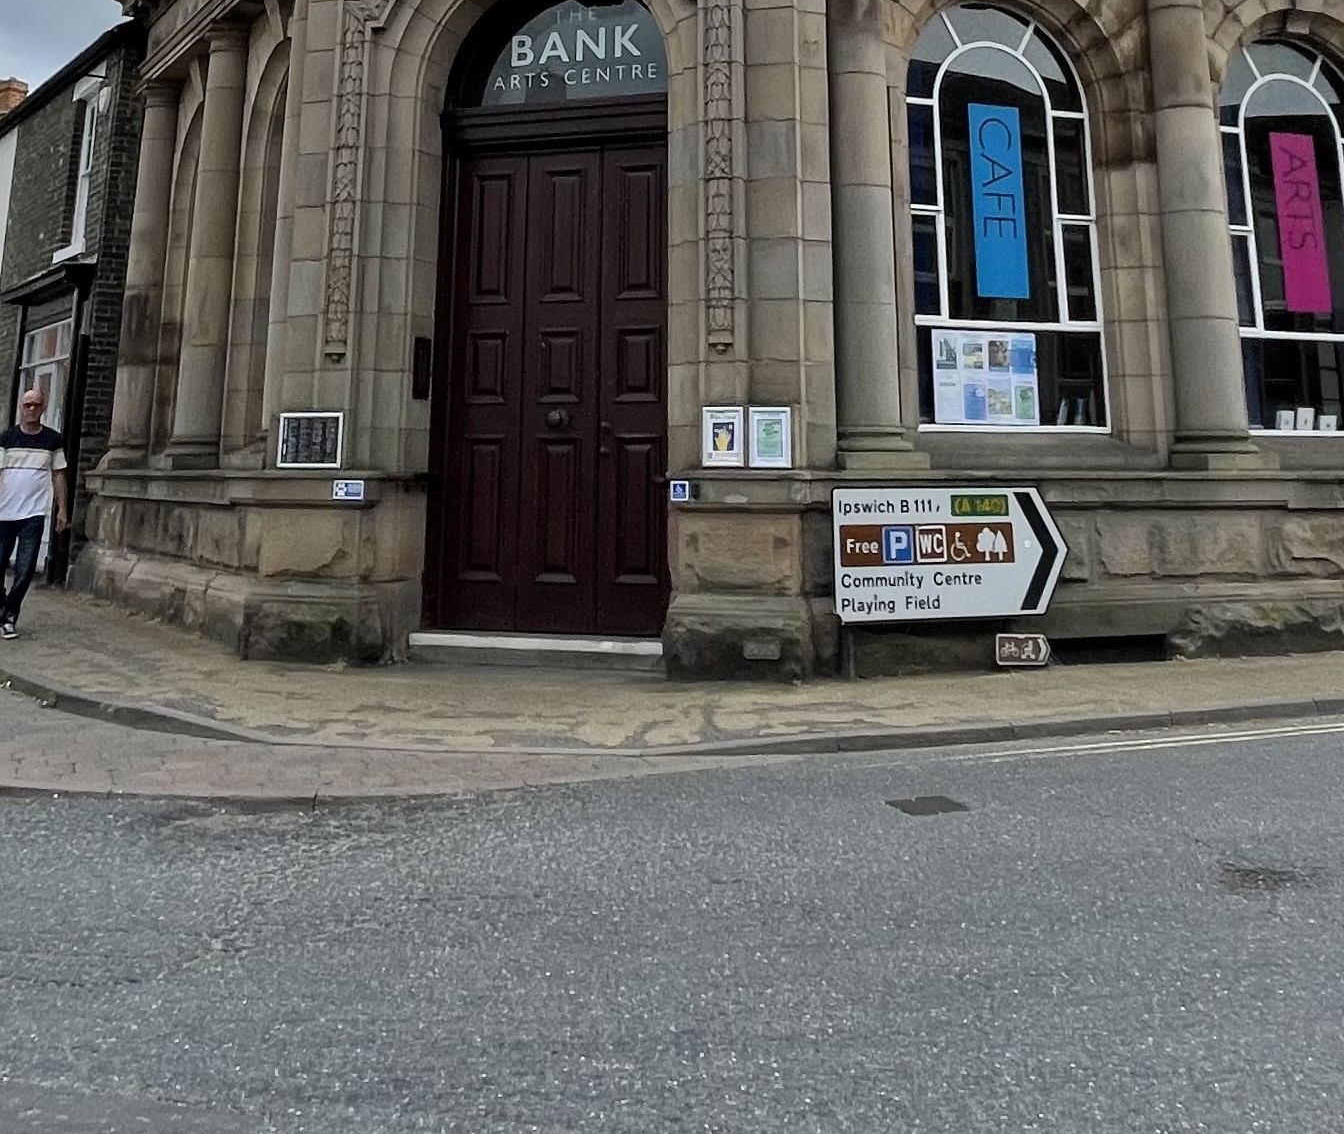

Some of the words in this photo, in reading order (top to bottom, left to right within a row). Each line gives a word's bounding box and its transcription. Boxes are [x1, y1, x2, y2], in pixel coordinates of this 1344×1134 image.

[510, 23, 642, 68] BANK
[493, 72, 550, 91] ARTS
[564, 63, 659, 86] CENTRE
[978, 117, 1017, 239] CAFE
[1278, 145, 1318, 251] ARTS
[838, 499, 895, 516] Ipswich
[900, 499, 910, 514] B
[846, 538, 879, 555] Free
[889, 532, 908, 559] P
[919, 533, 944, 554] WC
[841, 571, 924, 590] Community
[932, 571, 983, 586] Centre
[841, 594, 896, 615] Playing
[905, 594, 941, 610] Field
